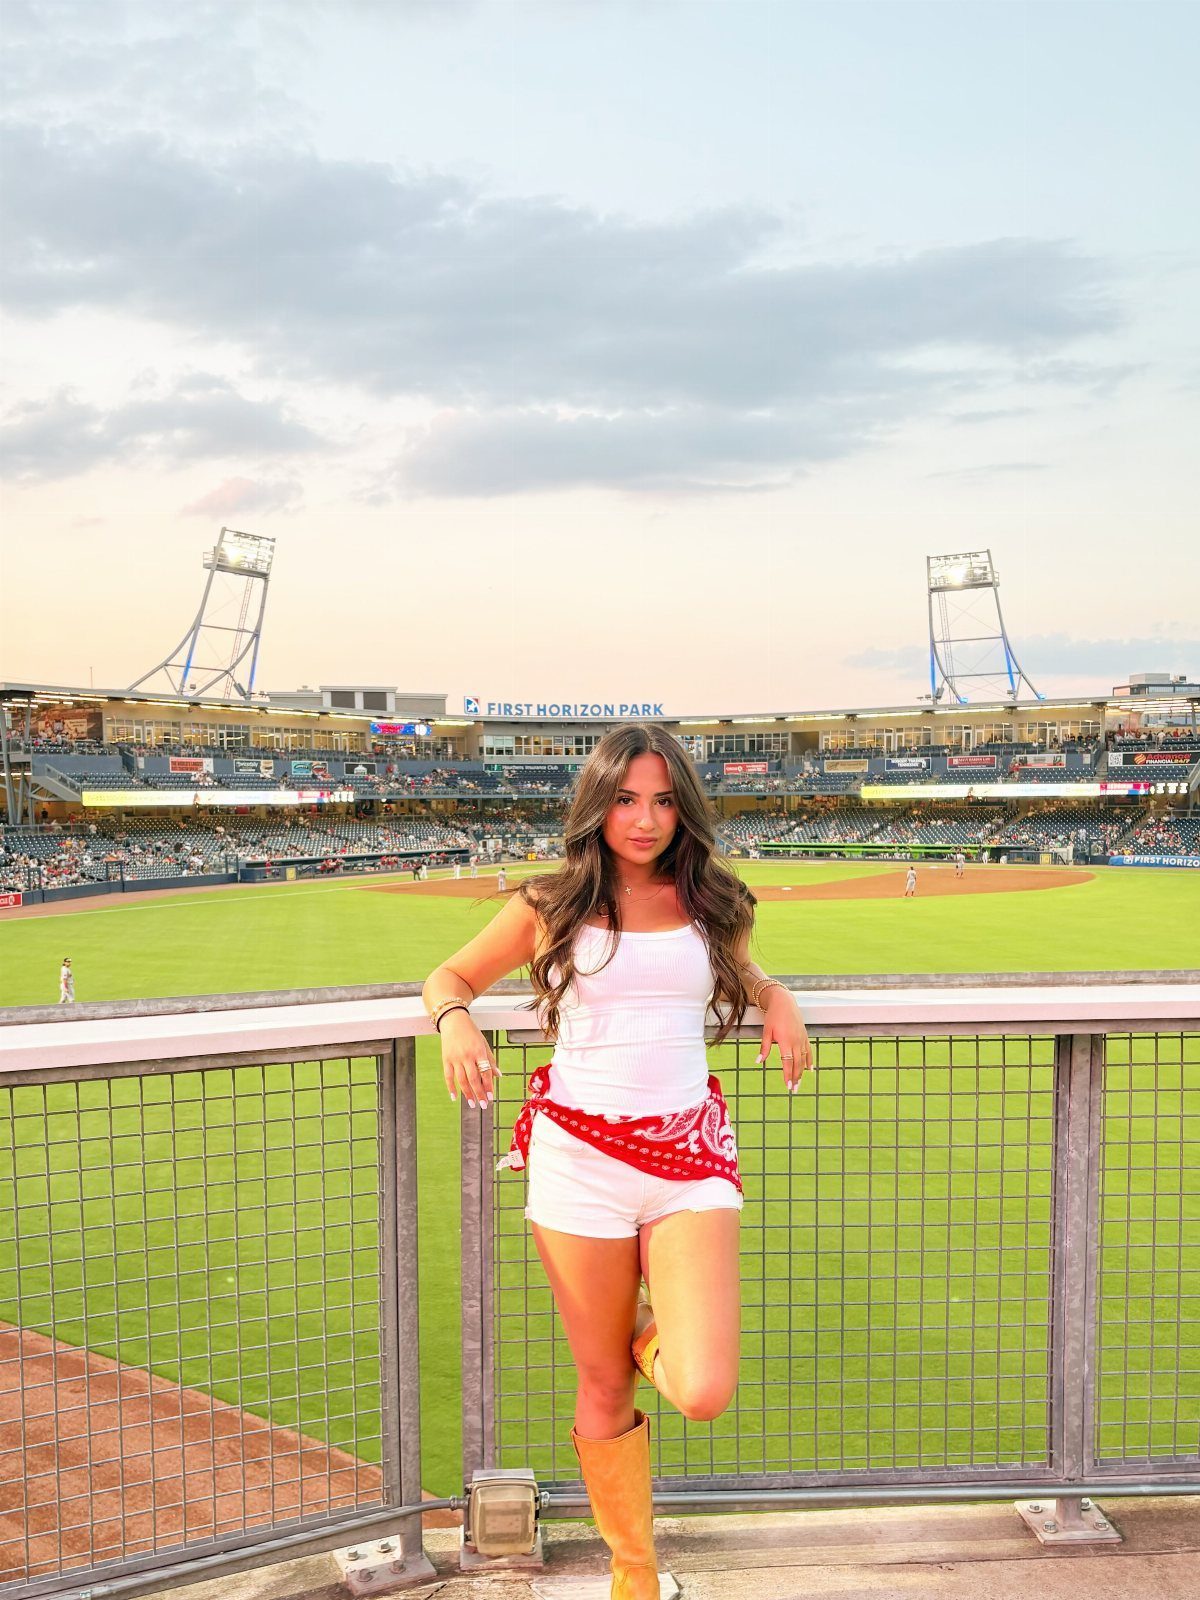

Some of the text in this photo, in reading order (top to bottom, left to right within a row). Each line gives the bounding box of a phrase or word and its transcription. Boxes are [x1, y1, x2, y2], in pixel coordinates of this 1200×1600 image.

[487, 703, 664, 717] FIRST HORIZON PARK
[1135, 856, 1161, 864] FIRST
